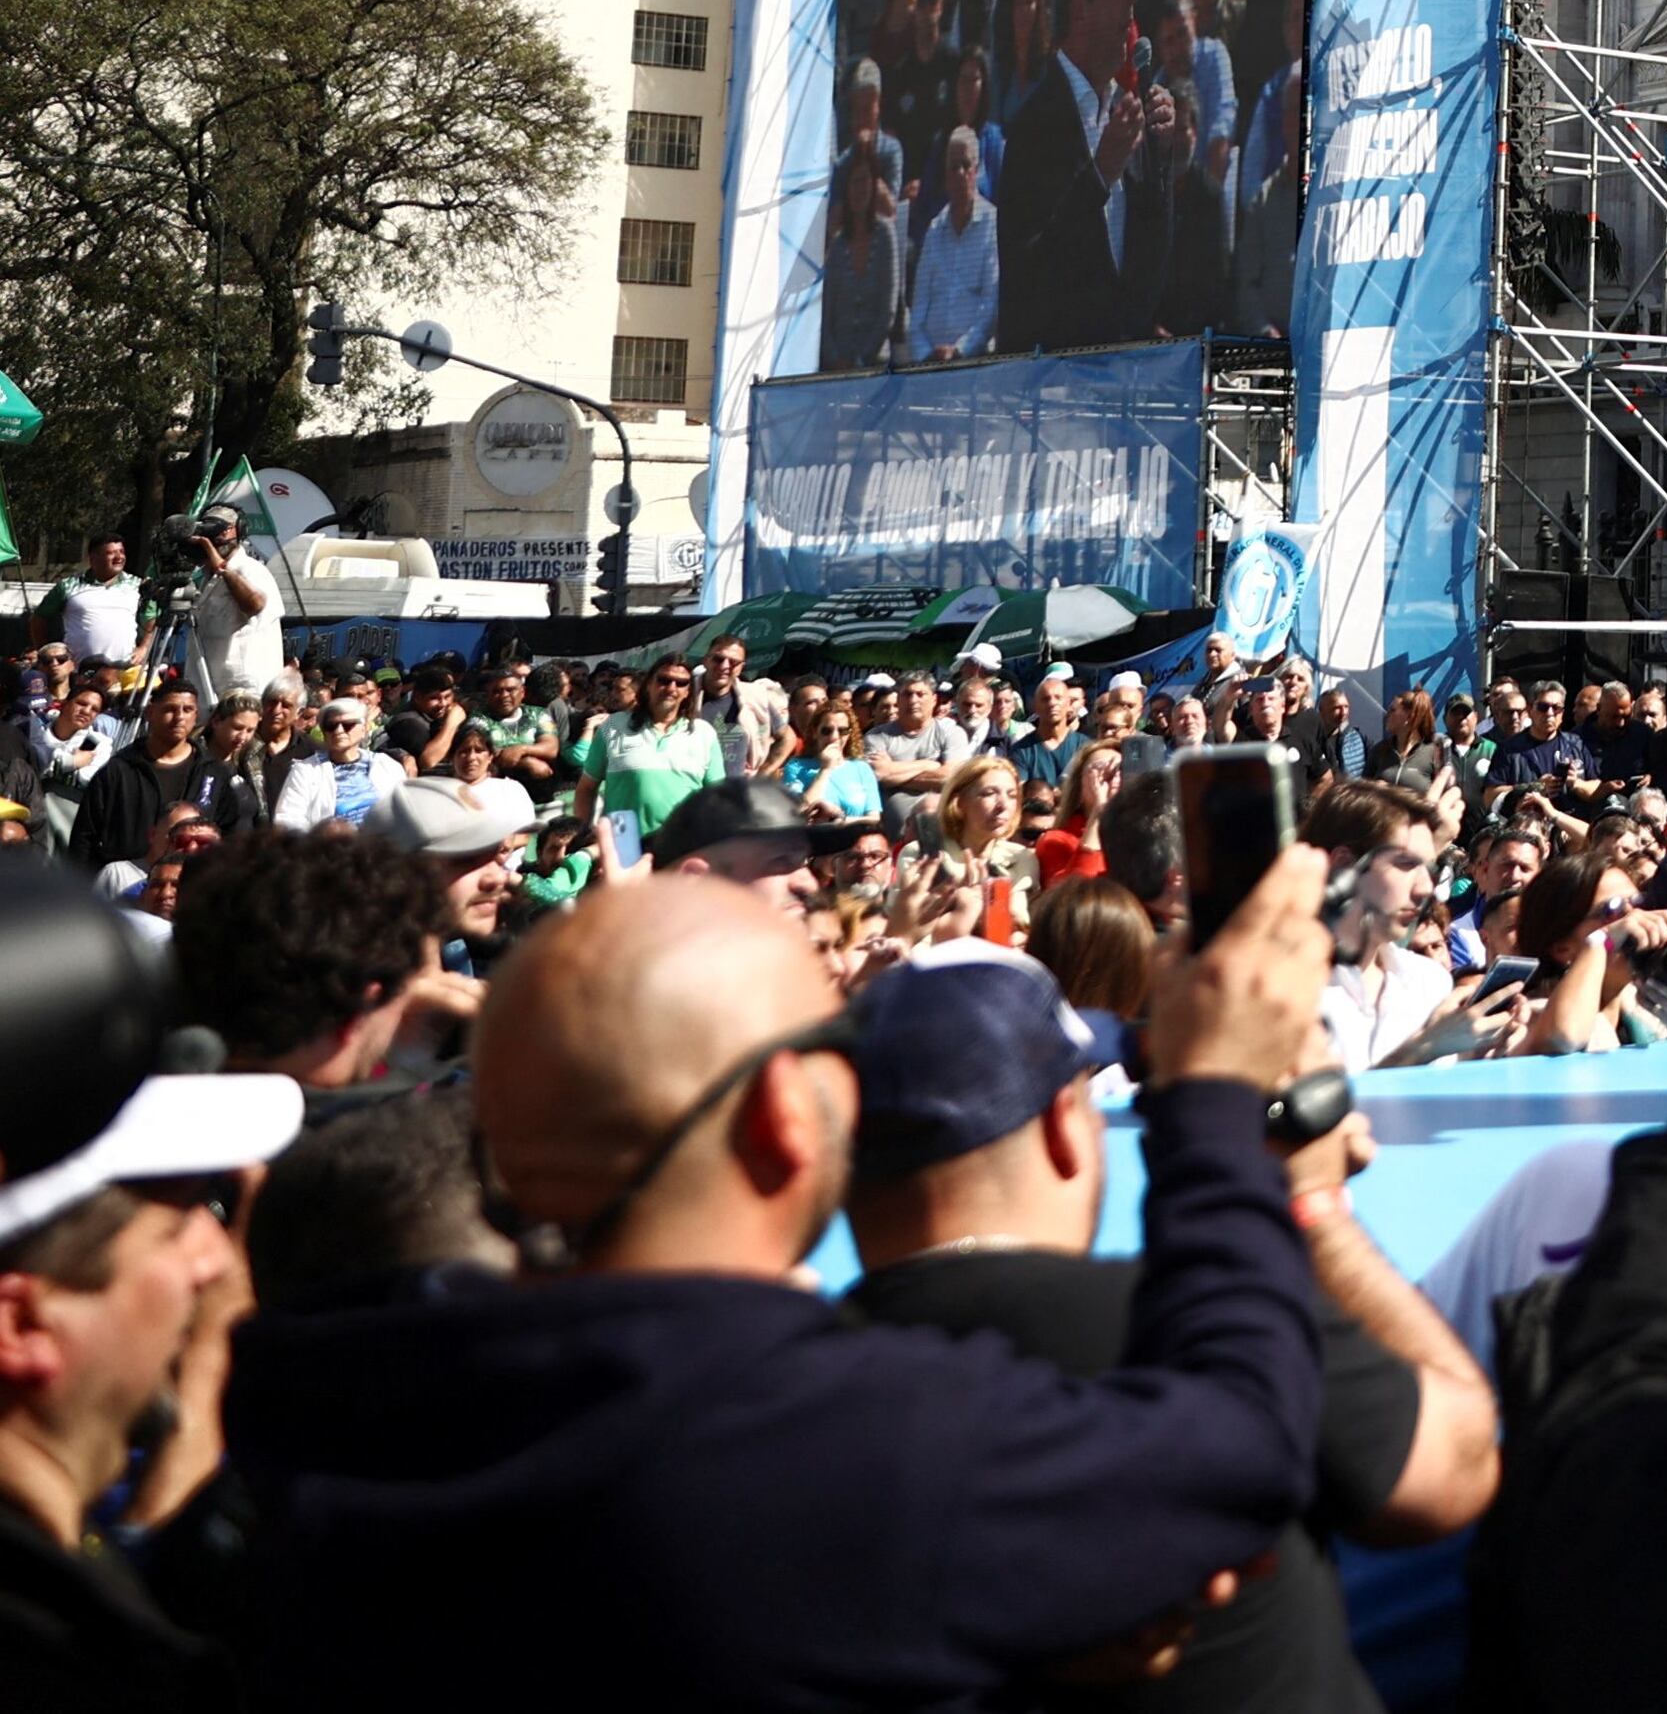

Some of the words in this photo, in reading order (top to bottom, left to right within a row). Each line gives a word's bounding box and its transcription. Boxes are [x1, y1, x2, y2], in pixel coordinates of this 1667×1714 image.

[1327, 192, 1426, 266] TRABAJO
[1041, 445, 1170, 540] TRABAJO
[433, 540, 517, 559] PANADEROS
[438, 561, 492, 581] ASTON
[500, 560, 561, 579] FRUTOS
